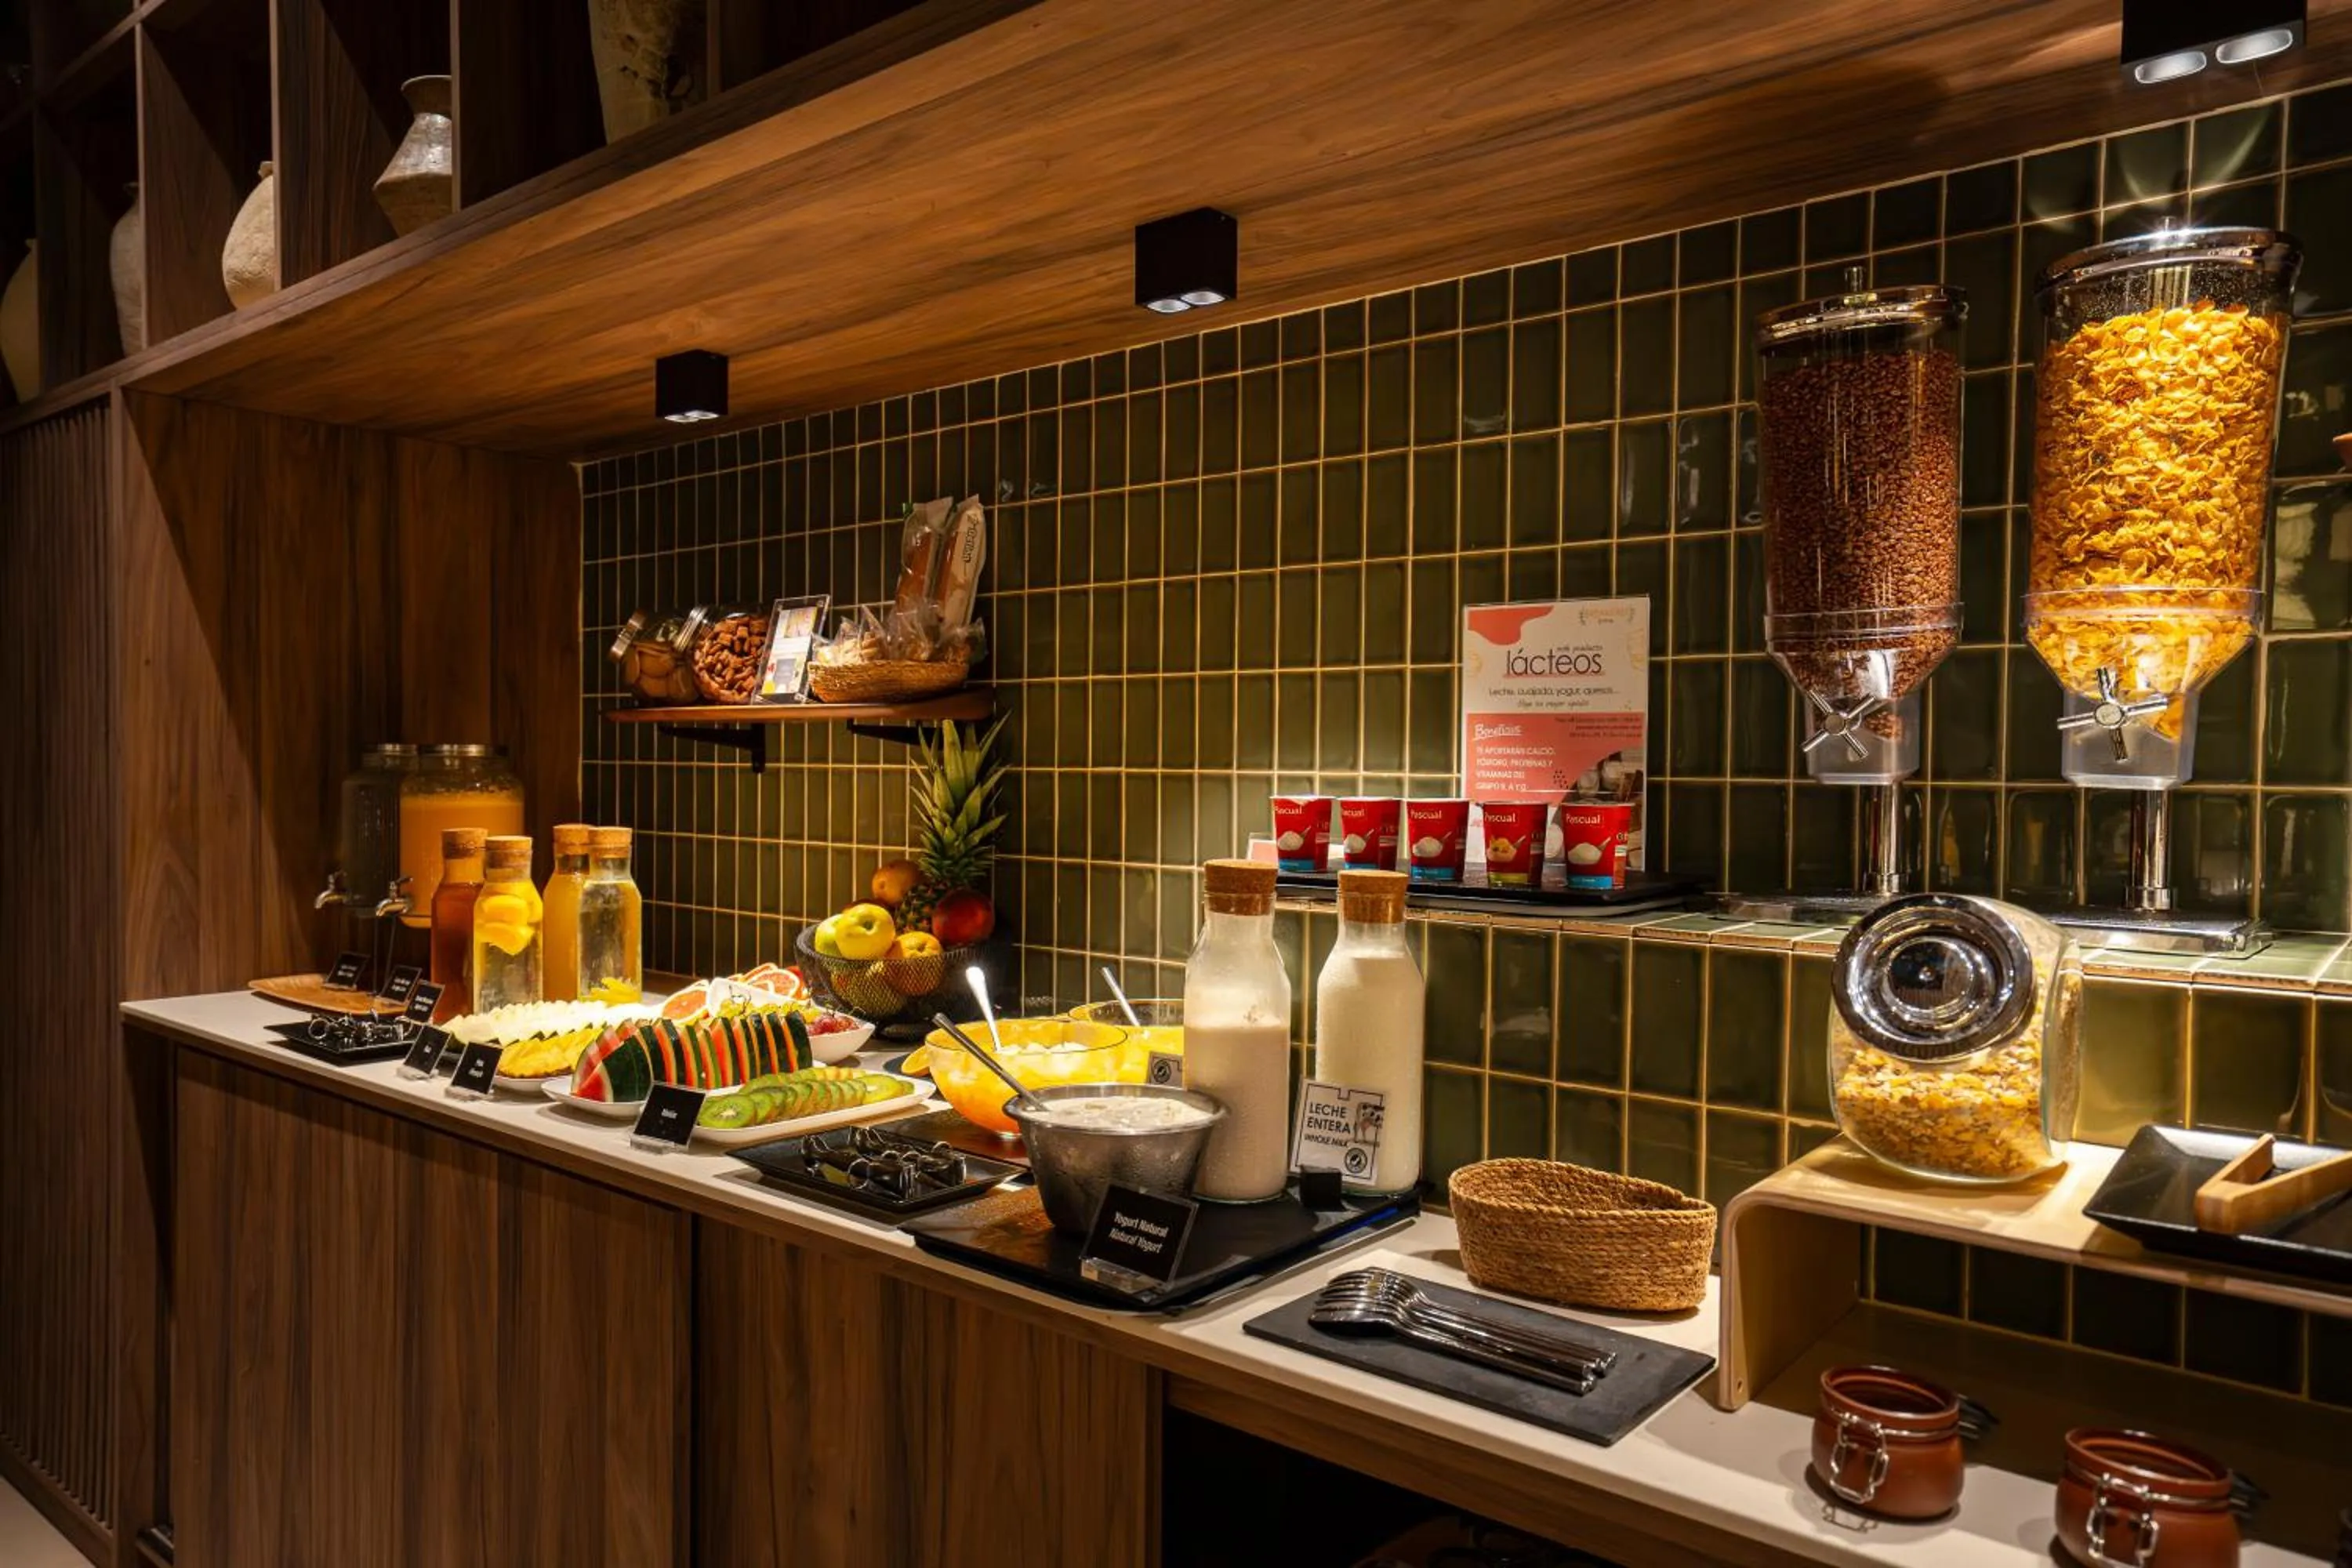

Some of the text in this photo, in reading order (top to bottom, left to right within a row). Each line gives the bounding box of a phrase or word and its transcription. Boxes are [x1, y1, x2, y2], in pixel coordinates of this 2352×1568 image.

[1506, 647, 1602, 676] lácteos
[1566, 813, 1601, 825] Pascual
[1309, 1102, 1348, 1119] LECHE
[1307, 1116, 1351, 1134] ENTERA
[1109, 1227, 1139, 1246] Natural
[1138, 1219, 1170, 1238] Natural
